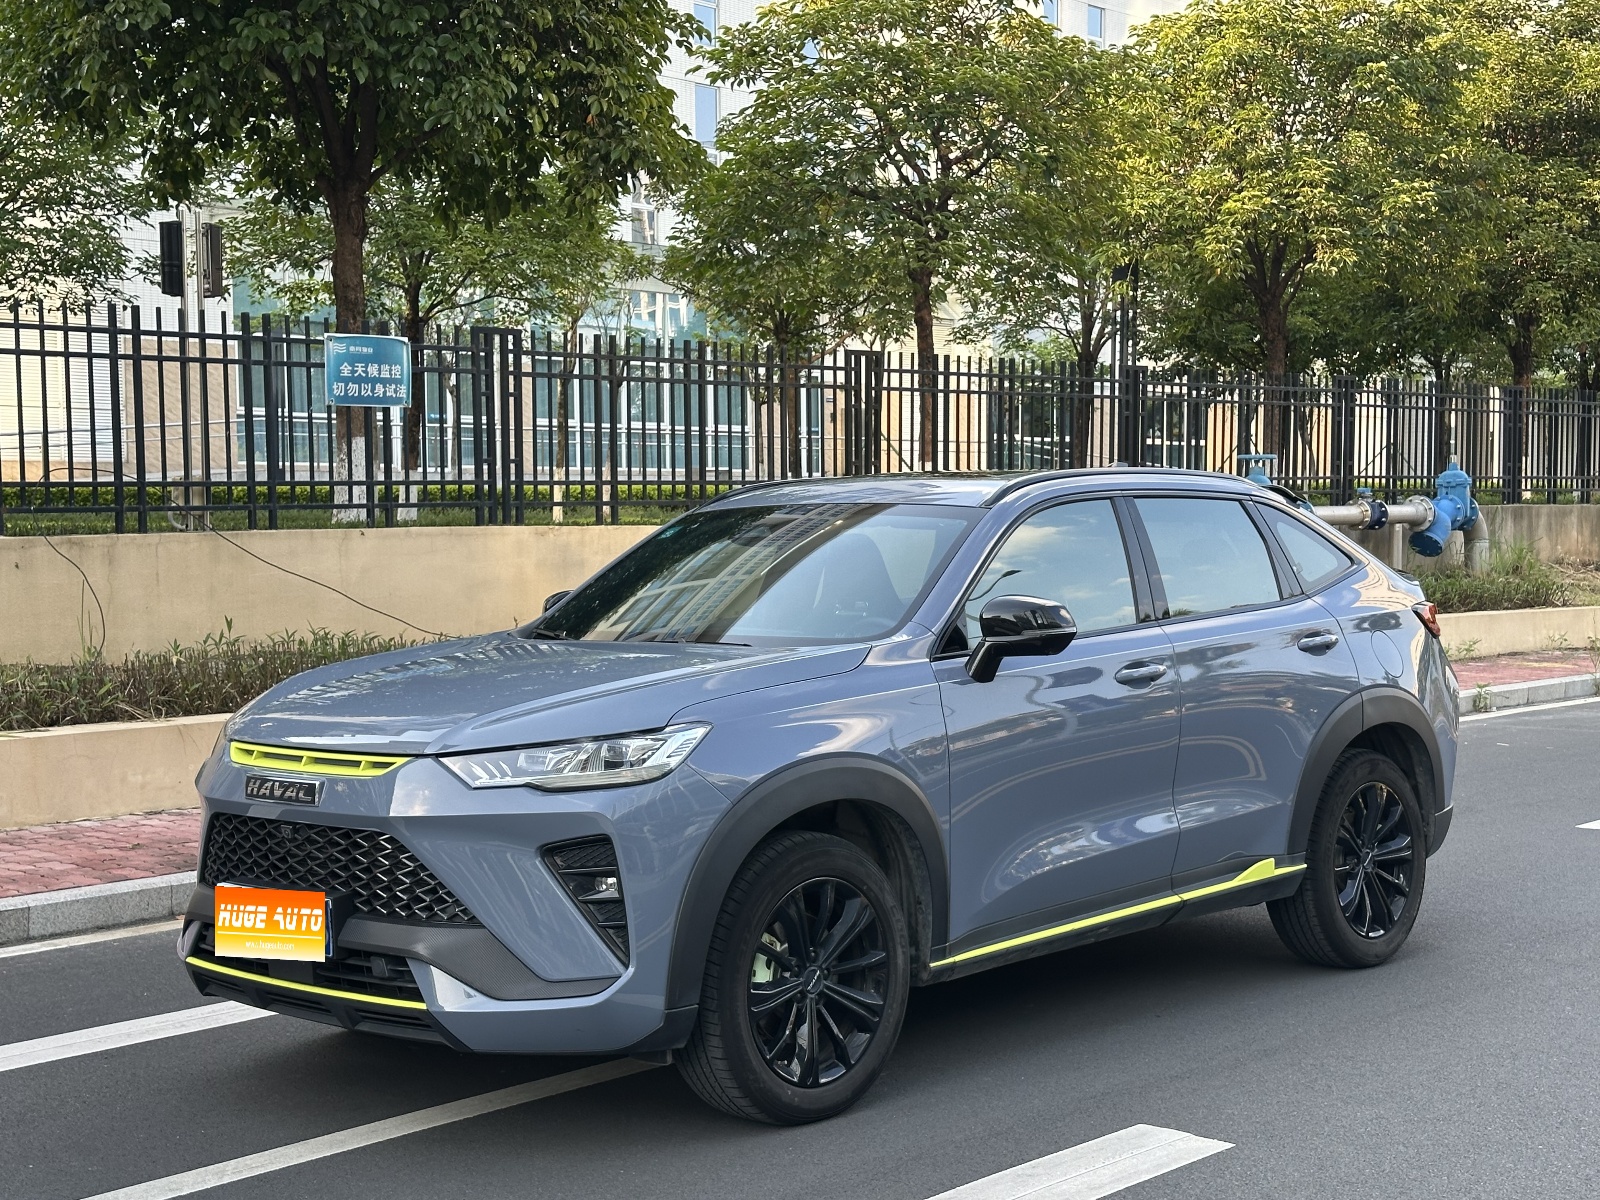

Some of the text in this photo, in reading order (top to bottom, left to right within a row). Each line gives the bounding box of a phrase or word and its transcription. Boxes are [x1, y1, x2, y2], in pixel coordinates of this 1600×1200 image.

[340, 362, 402, 378] 全天候监控
[333, 382, 407, 398] 切勿以身试法
[247, 779, 312, 802] HAVAL
